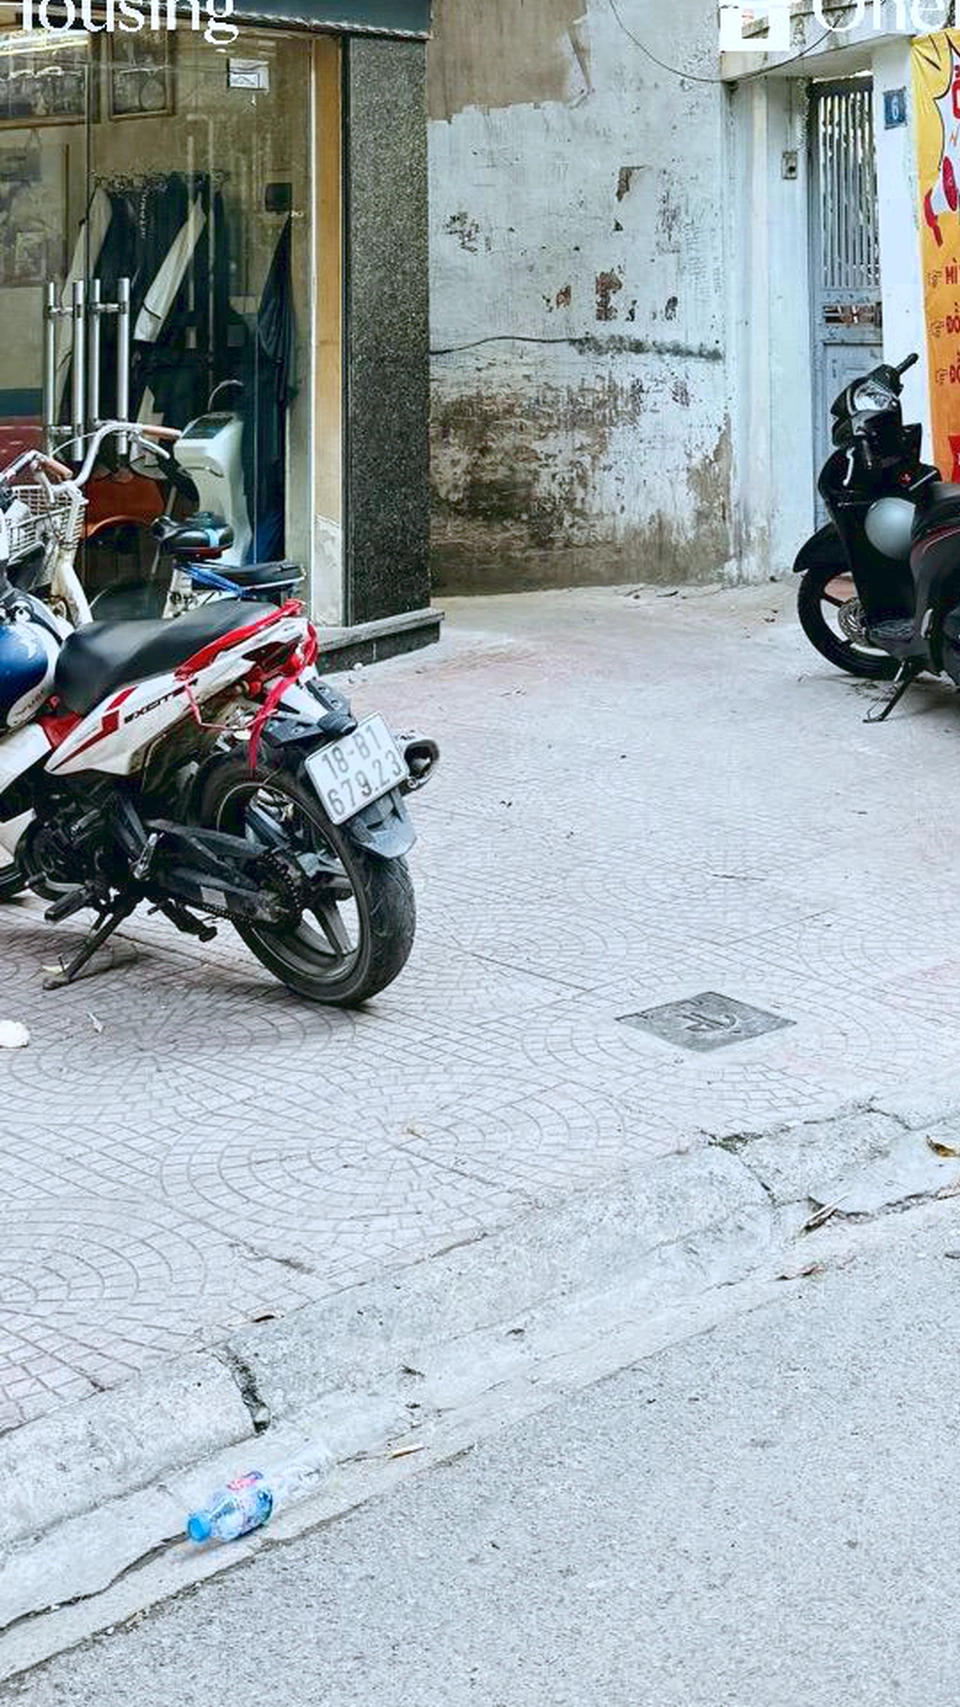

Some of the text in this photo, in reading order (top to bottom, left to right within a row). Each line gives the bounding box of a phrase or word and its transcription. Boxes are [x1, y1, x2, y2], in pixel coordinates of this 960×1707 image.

[946, 302, 960, 334] ĐỒ
[320, 725, 385, 780] 18-B1
[328, 749, 402, 822] 679.23
